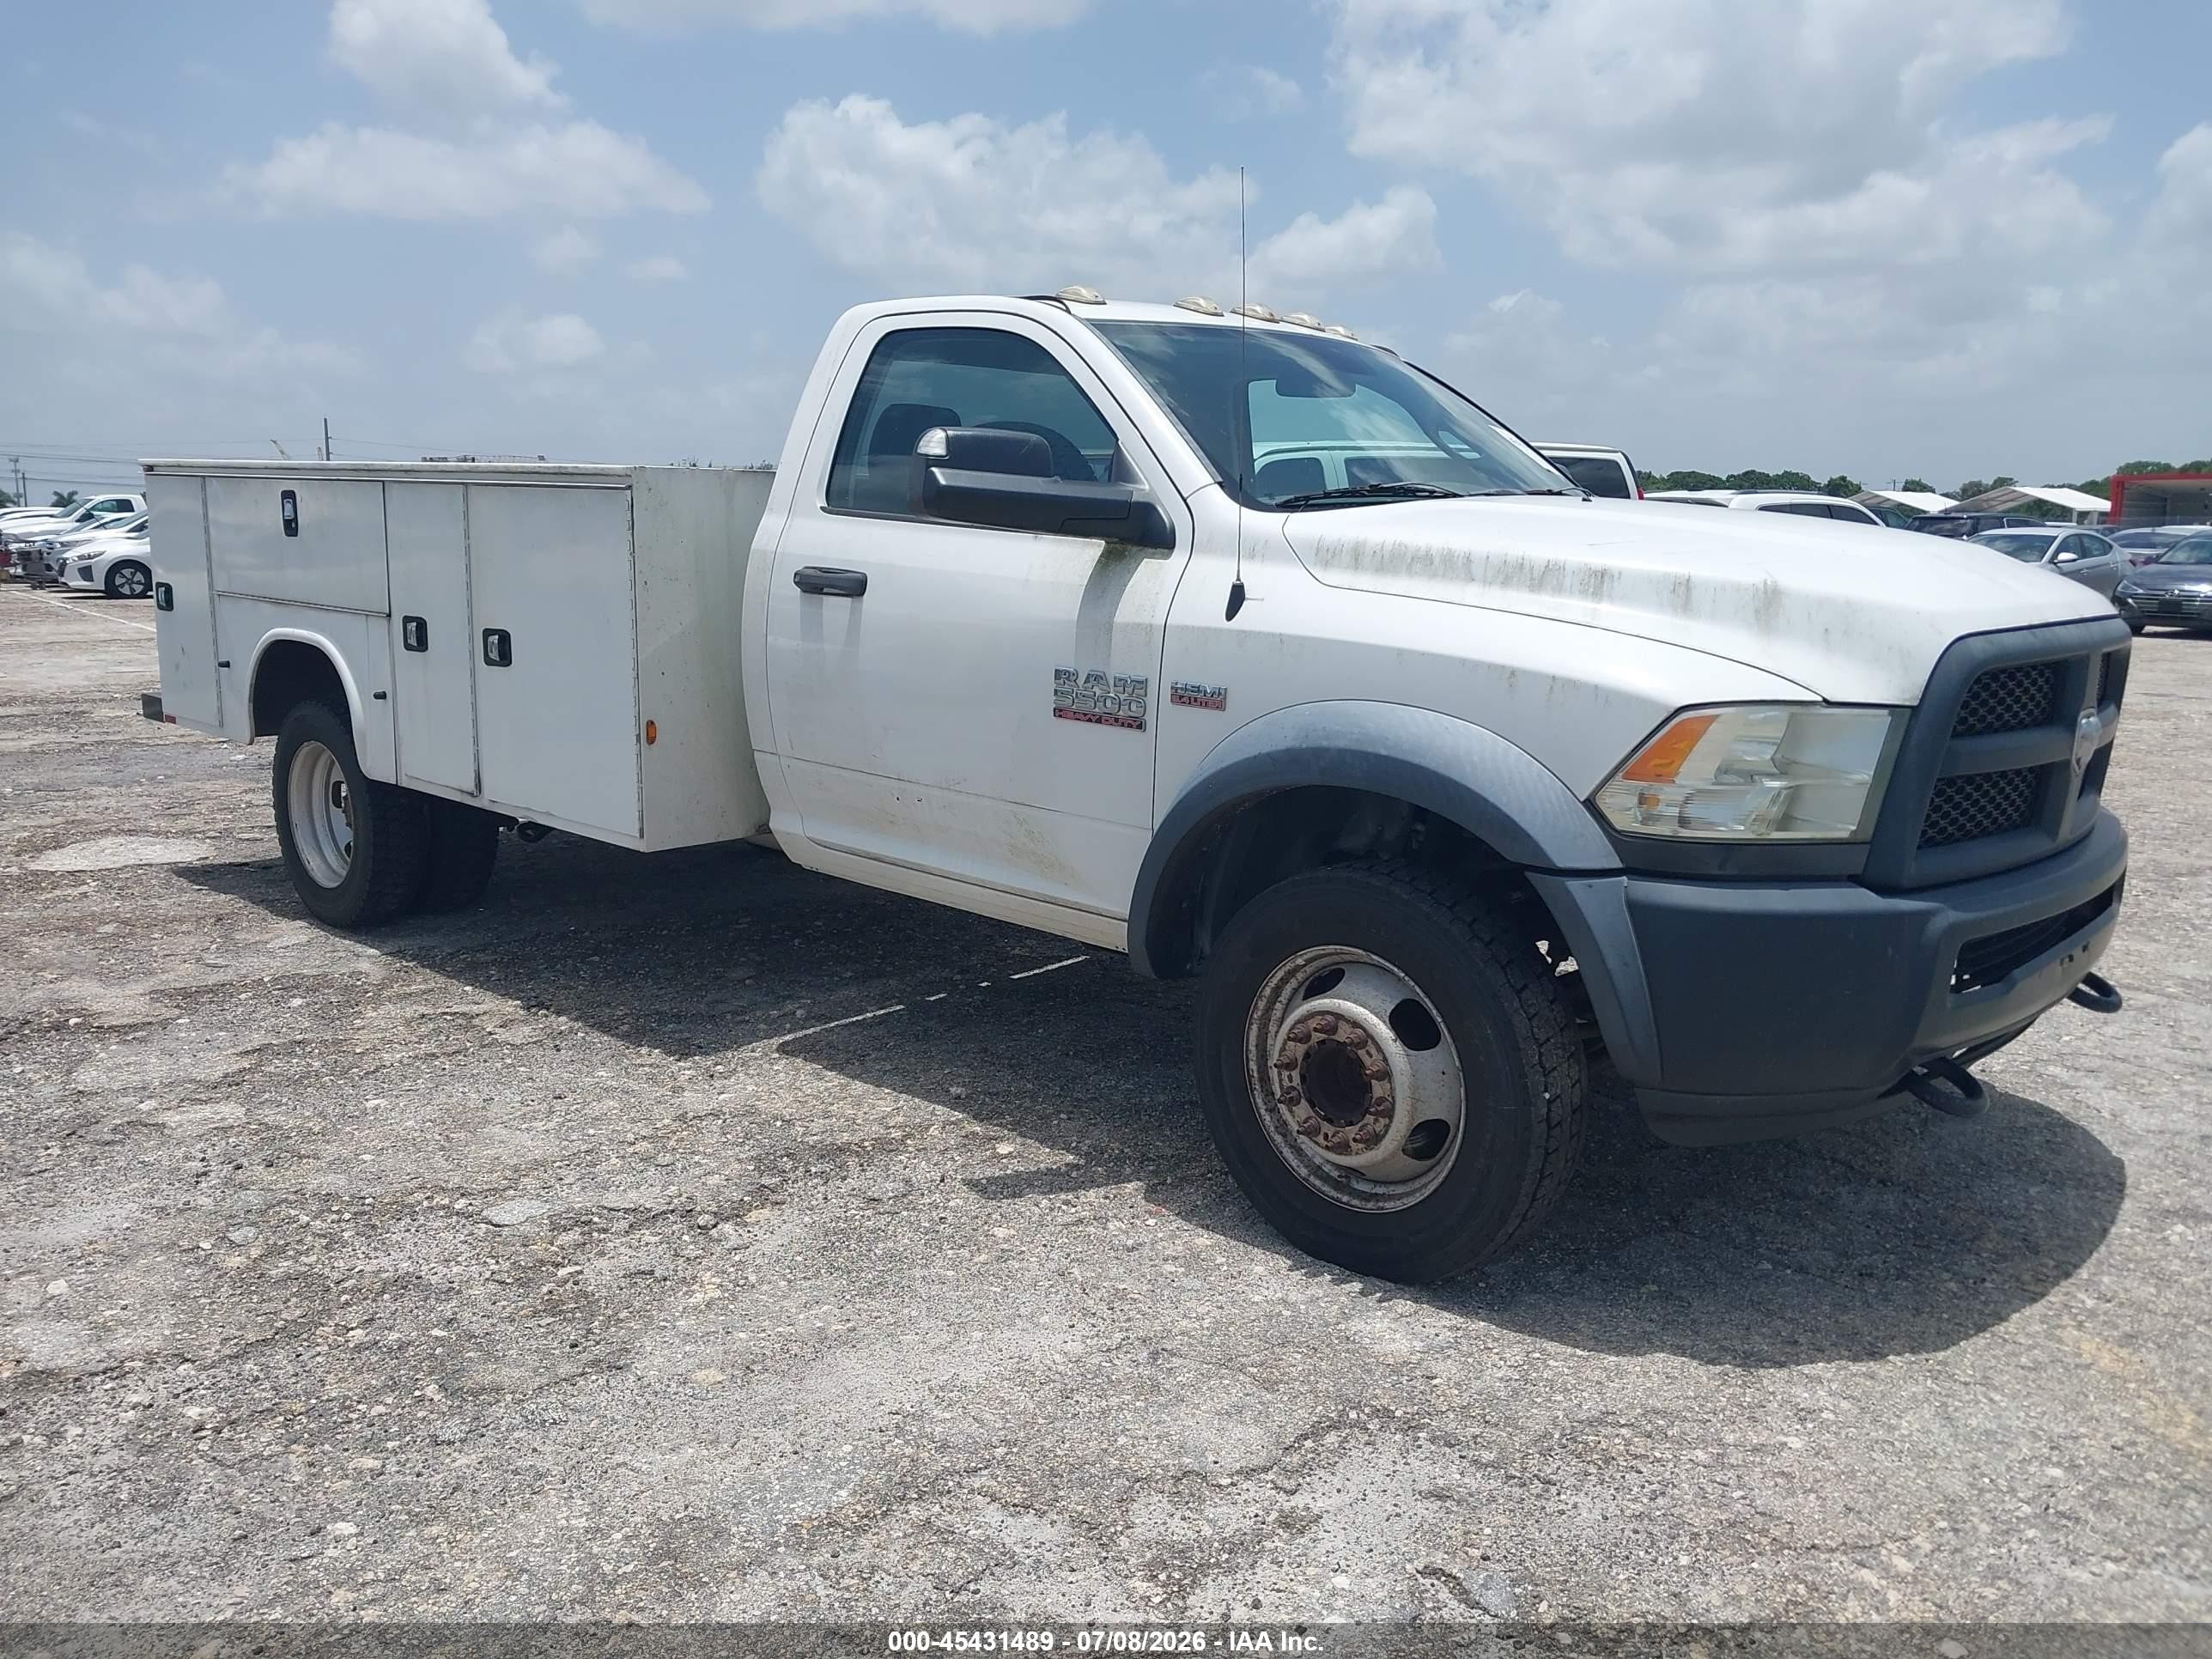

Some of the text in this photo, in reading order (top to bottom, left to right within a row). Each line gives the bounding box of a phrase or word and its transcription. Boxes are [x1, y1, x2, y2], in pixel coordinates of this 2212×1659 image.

[1054, 667, 1147, 696] RAM
[1170, 682, 1226, 699] HEMI
[1054, 687, 1146, 717] 5500
[1190, 696, 1222, 709] LITER
[1057, 709, 1141, 729] HEAVY DUTY
